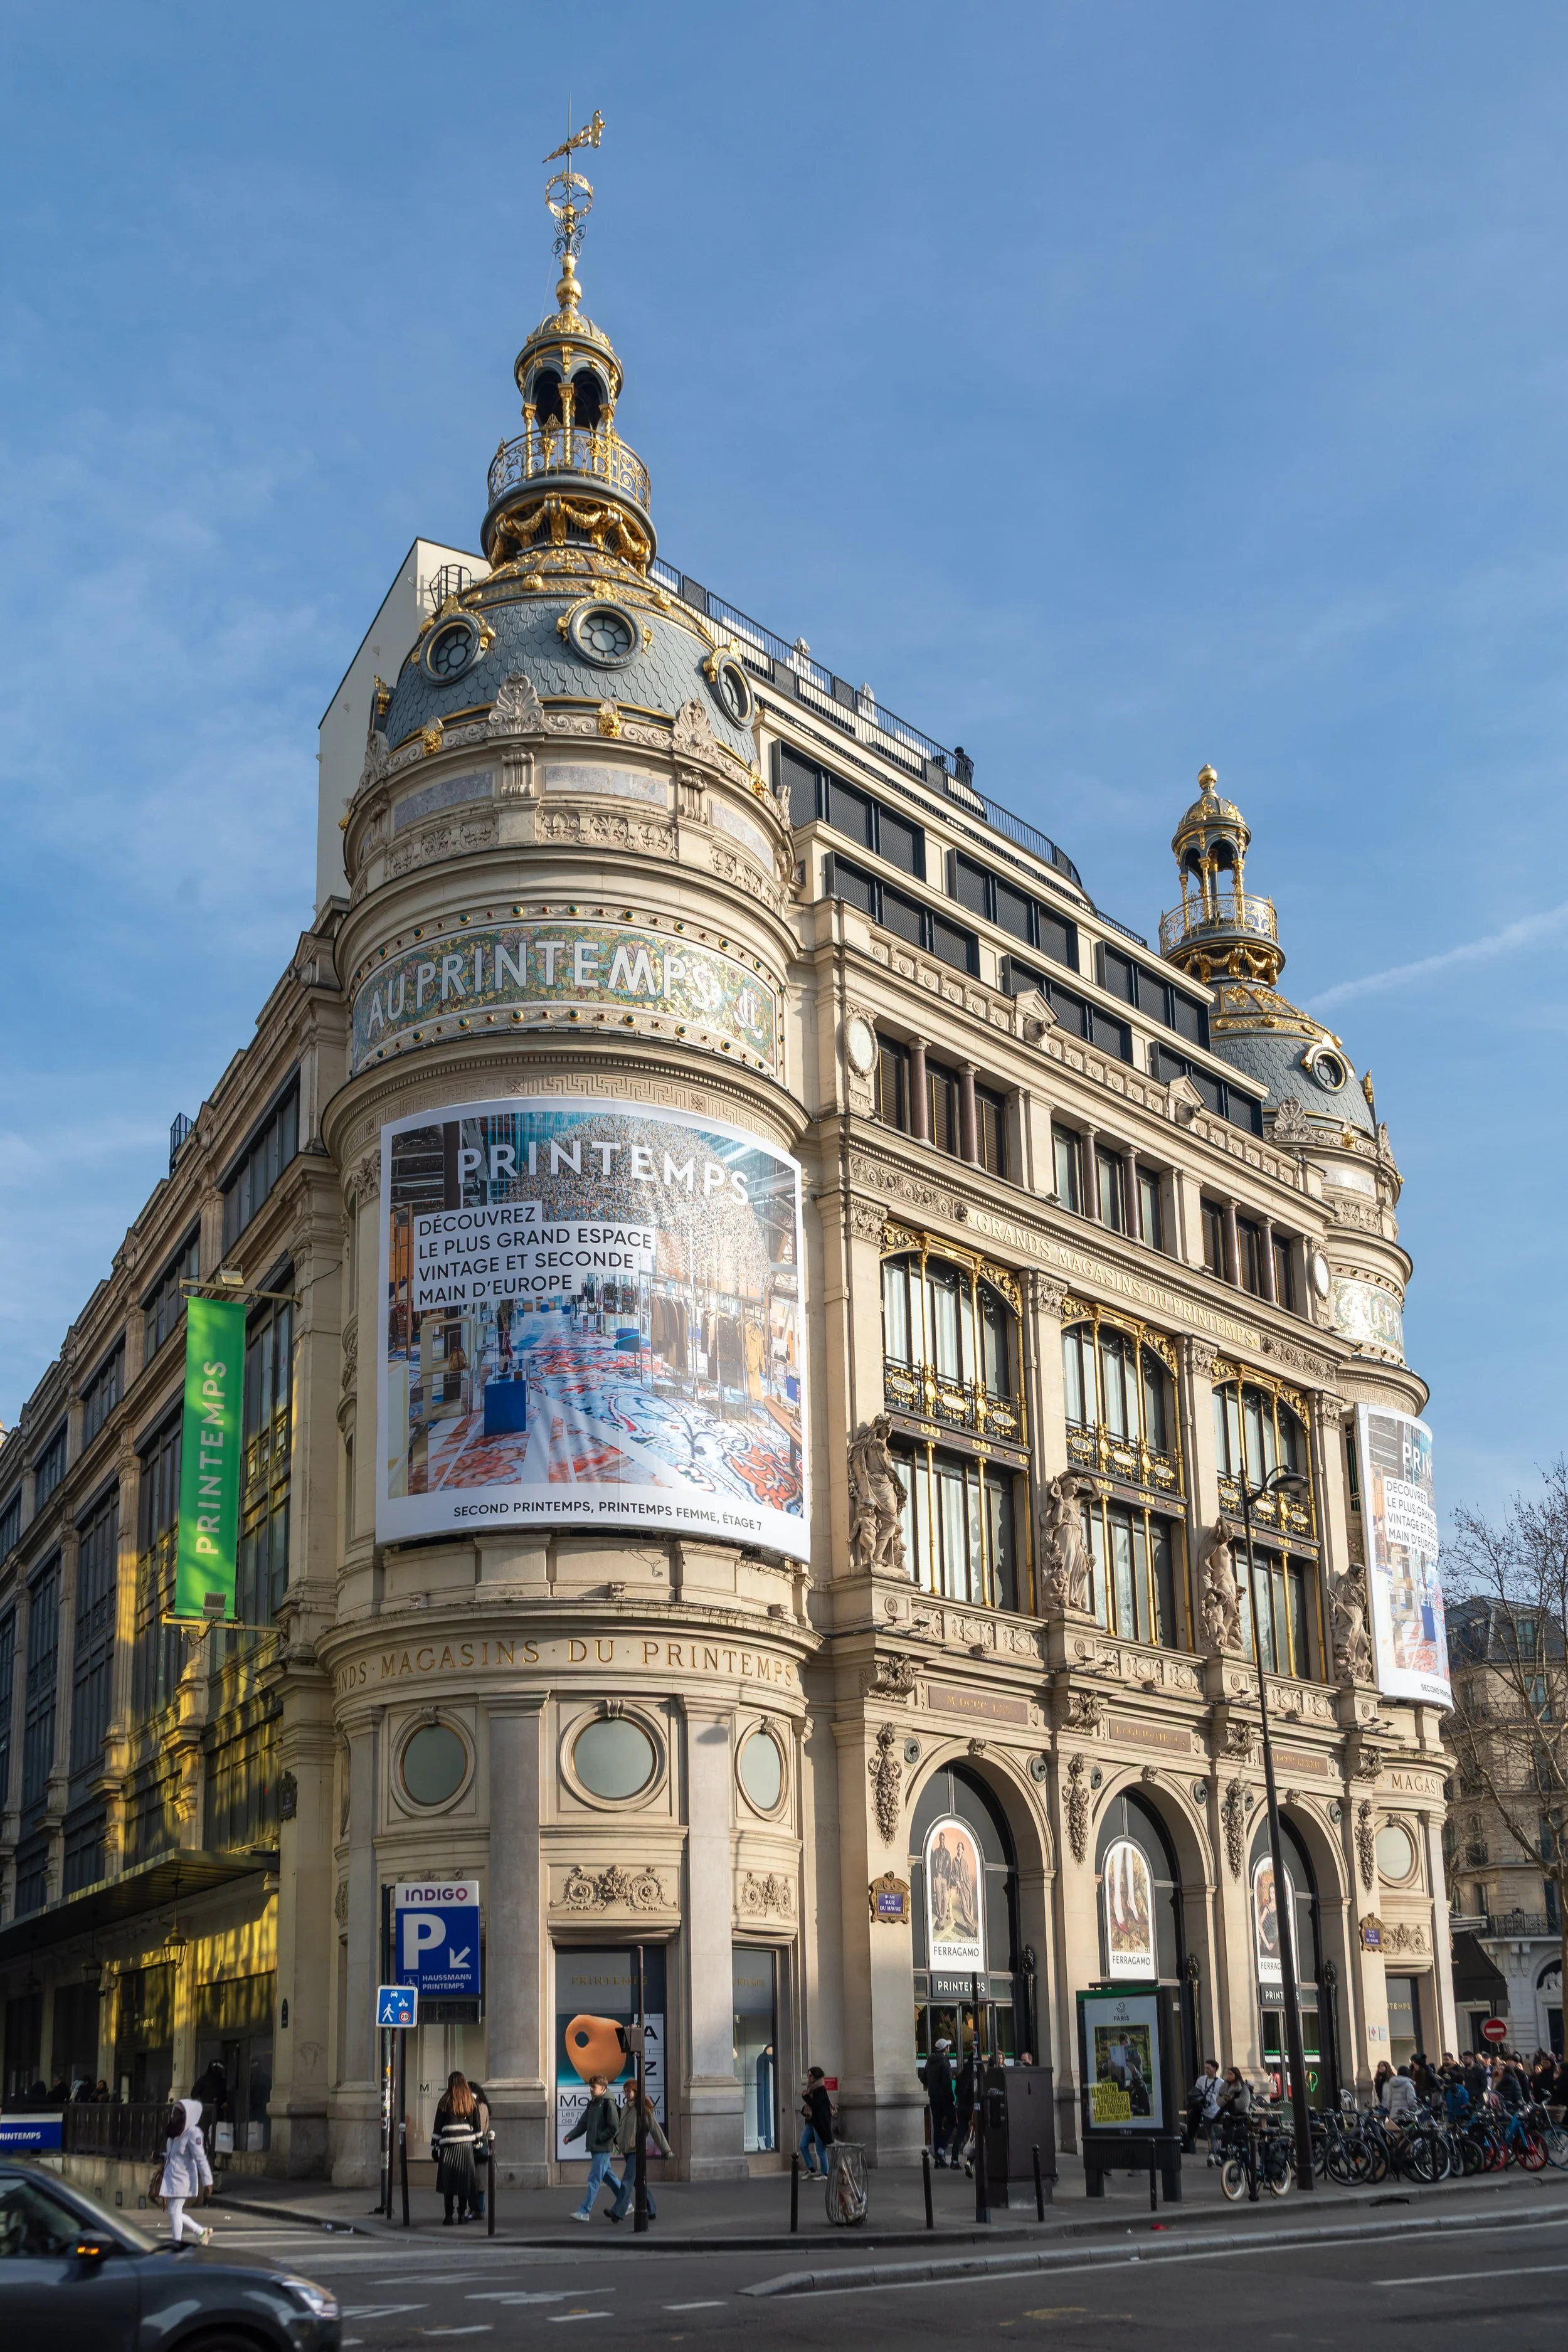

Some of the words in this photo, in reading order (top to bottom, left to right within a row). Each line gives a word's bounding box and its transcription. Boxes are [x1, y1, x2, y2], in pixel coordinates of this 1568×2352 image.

[366, 973, 405, 1039] AU
[416, 941, 710, 1009] PRINTEMPS
[458, 1140, 749, 1205] PRINTEMPS
[419, 1207, 536, 1237] DÉCOUVREZ
[419, 1243, 438, 1259] LE
[444, 1234, 490, 1256] PLUS
[496, 1228, 570, 1248] GRAND
[578, 1227, 652, 1250] ESPACE
[419, 1258, 500, 1282] VINTAGE
[506, 1254, 526, 1270] ET
[534, 1251, 634, 1269] SECONDE
[977, 1212, 1052, 1260] GRANDS
[1057, 1245, 1142, 1300] MAGASINS
[1147, 1286, 1168, 1310] DU
[1173, 1296, 1253, 1348] PRINTEMPS
[419, 1284, 466, 1306] MAIN
[473, 1275, 573, 1298] D'EUROPE
[196, 1360, 226, 1555] PRINTEMPS
[1387, 1480, 1426, 1505] DÉCOUVREZ
[1387, 1496, 1396, 1508] LE
[1399, 1500, 1416, 1514] PLUS
[453, 1503, 509, 1517] SECOND
[514, 1501, 595, 1514] PRINTEMPS,
[599, 1501, 673, 1517] PRINTEMPS
[675, 1507, 719, 1524] FEMME,
[723, 1511, 755, 1530] ÉTAGE
[756, 1520, 762, 1530] 7
[1387, 1512, 1419, 1531] VINTAGE
[1421, 1523, 1426, 1534] ET
[1389, 1528, 1409, 1542] MAIN
[380, 1639, 539, 1679] MAGASINS
[567, 1639, 614, 1663] DU
[641, 1641, 793, 1688] PRINTEMPS
[1421, 1684, 1439, 1695] SECOND
[405, 1887, 468, 1902] INDIGO
[403, 1914, 447, 1969] P
[933, 1946, 980, 1957] FERRAGAMO
[1112, 1955, 1151, 1966] FERRAGAMO
[1261, 1962, 1281, 1971] FERRAG
[1265, 1991, 1300, 2000] PRINTS
[420, 2084, 429, 2092] M
